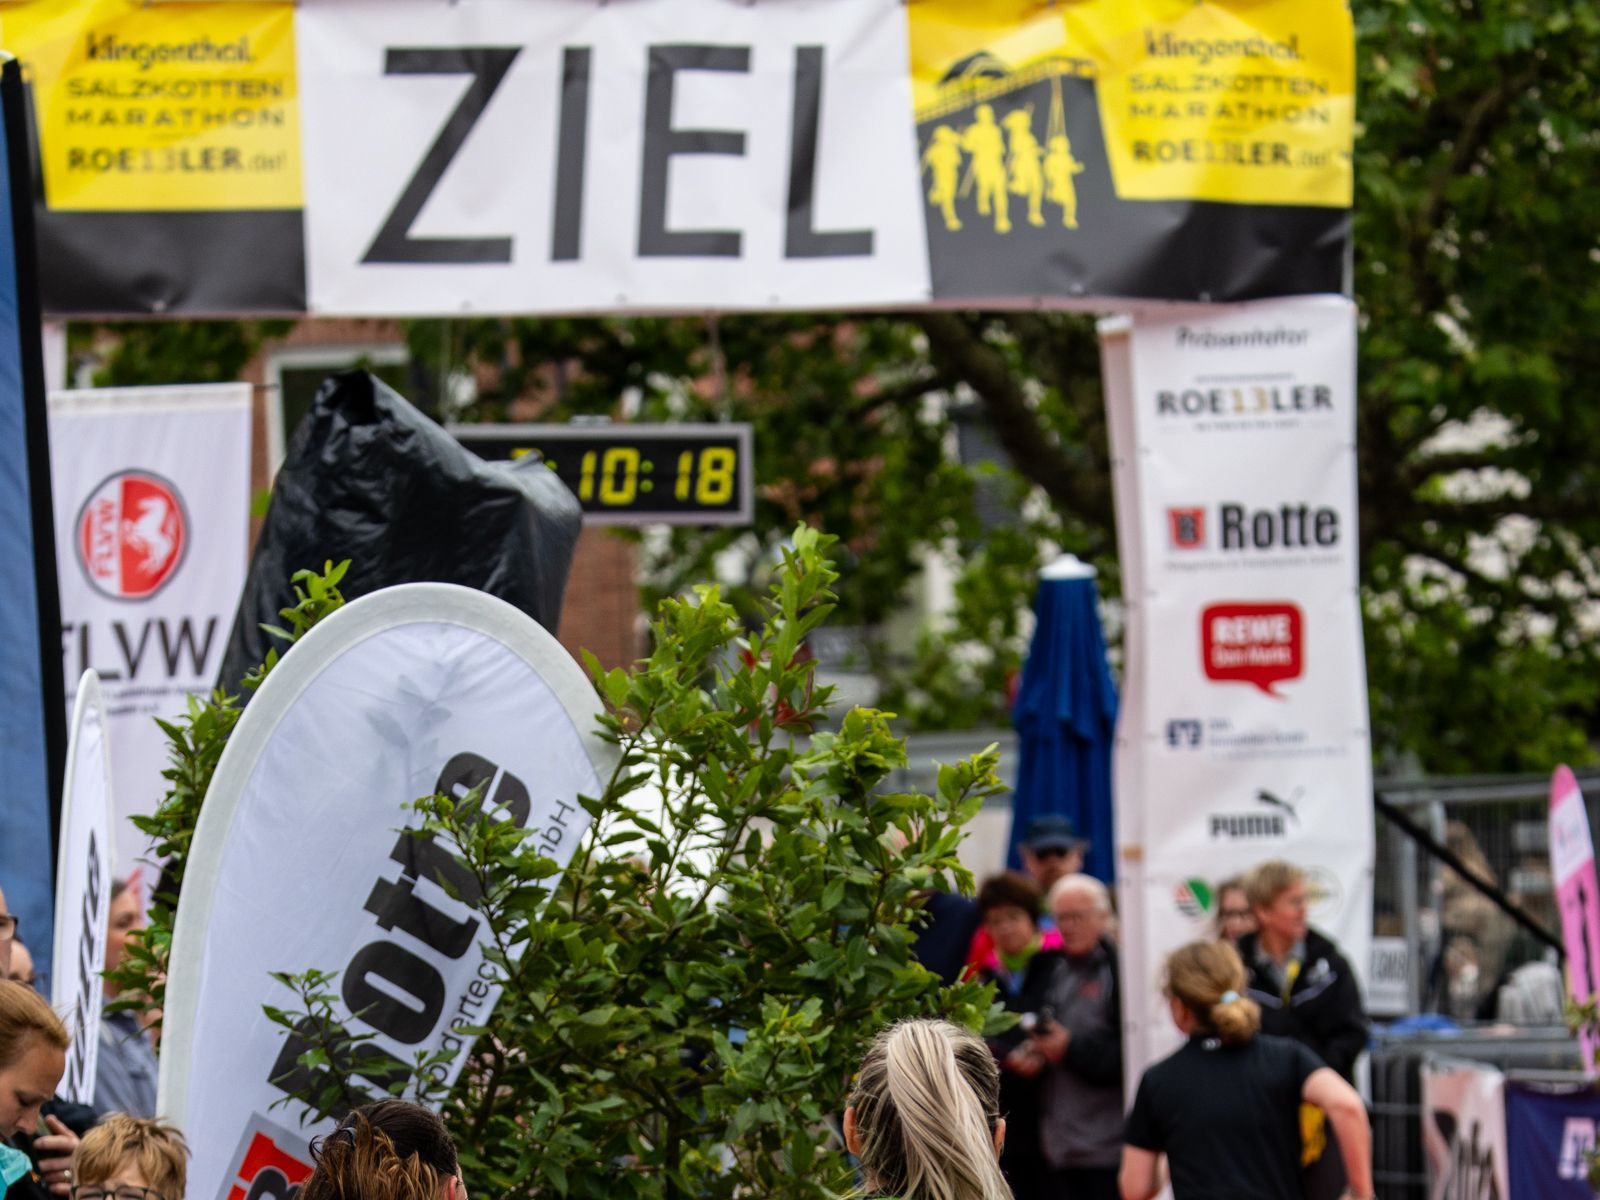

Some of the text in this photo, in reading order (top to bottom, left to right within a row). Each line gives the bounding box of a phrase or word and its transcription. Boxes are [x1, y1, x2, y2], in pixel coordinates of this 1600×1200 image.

[67, 77, 283, 98] SALZKOTTEN
[1129, 74, 1330, 95] SALZKOTTEN
[67, 107, 285, 126] MARATHON
[1129, 101, 1330, 124] MARATHON
[359, 44, 875, 265] ZIEL
[1221, 502, 1341, 551] Rotte
[1211, 613, 1292, 644] REWE
[61, 616, 220, 681] LVW
[1210, 815, 1285, 837] PUMA
